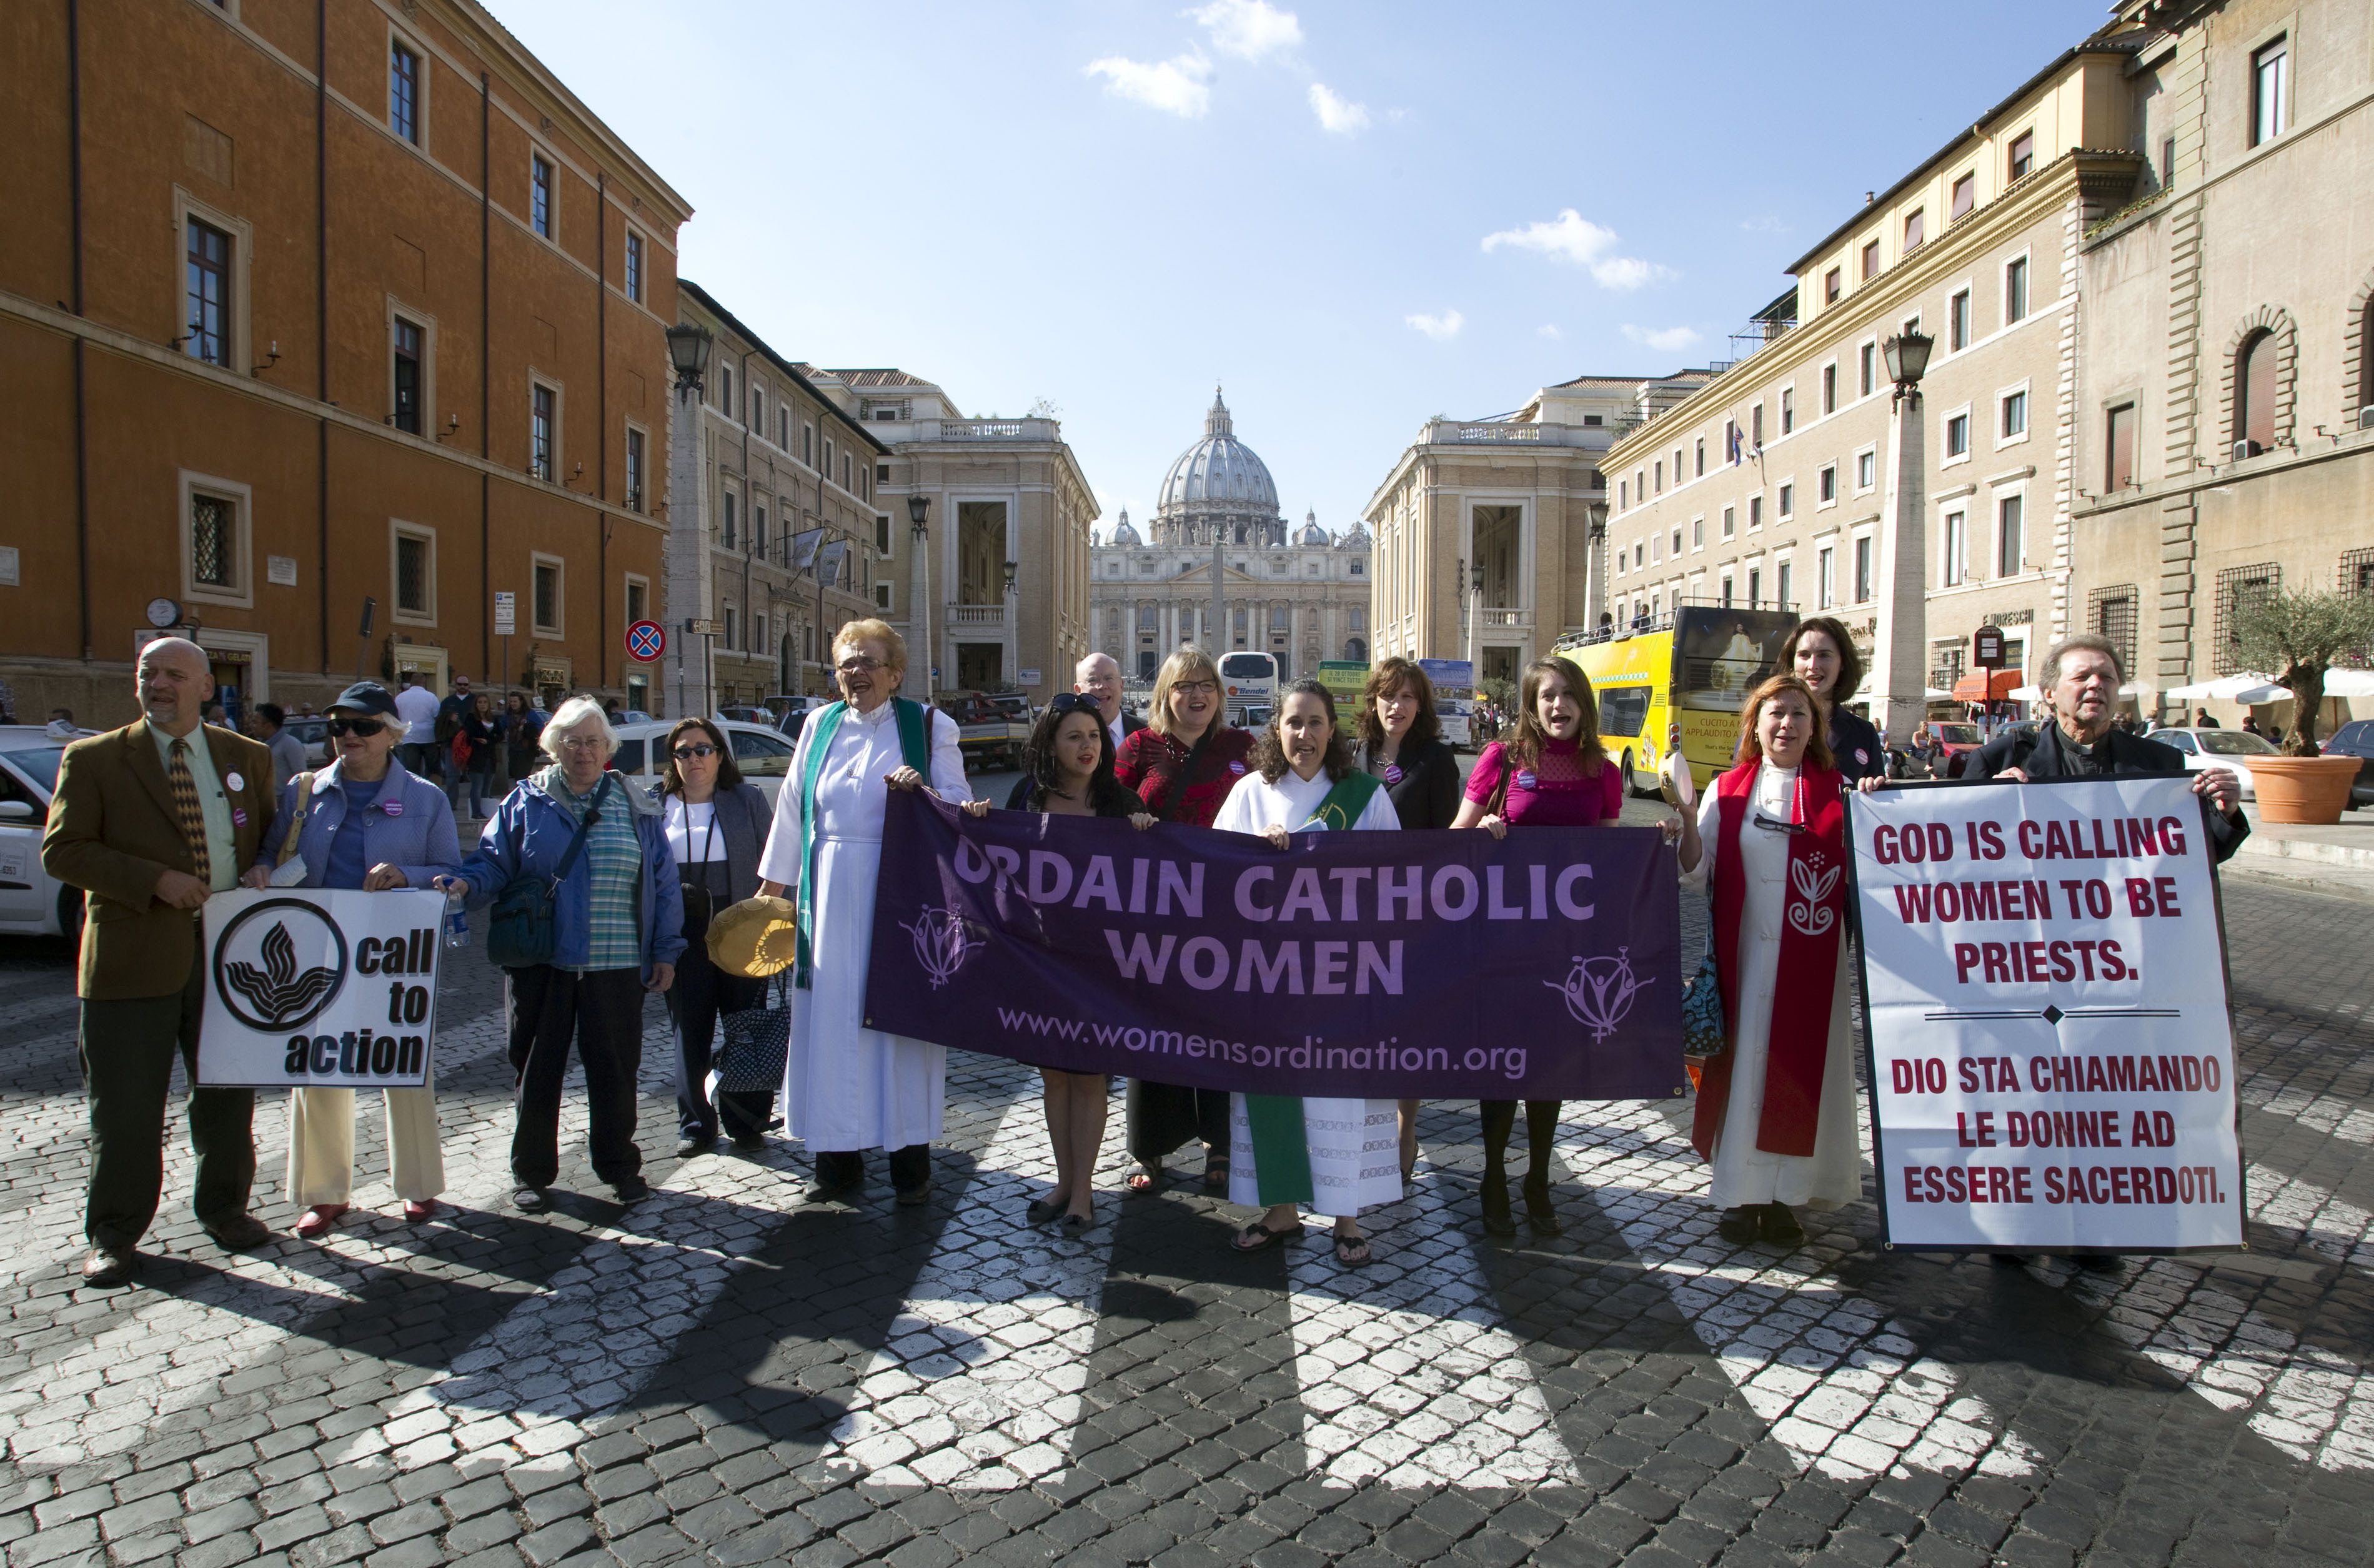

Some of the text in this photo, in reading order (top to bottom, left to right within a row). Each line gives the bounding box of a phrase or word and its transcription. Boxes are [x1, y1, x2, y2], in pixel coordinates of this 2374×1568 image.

[1990, 608, 2034, 627] MORESCHI
[402, 661, 418, 672] BAR
[1685, 728, 1732, 738] APPLAUDITO
[1700, 718, 1728, 727] CUCITO
[1874, 816, 2187, 865] GOD IS CALLING
[953, 833, 1596, 922] ORDAIN CATHOLIC
[1894, 876, 2182, 924] WOMEN TO BE
[355, 928, 435, 975] call
[1103, 929, 1404, 995] WOMEN
[1954, 940, 2139, 984] PRIESTS.
[389, 981, 429, 1024] to
[284, 1028, 424, 1075] action
[998, 1007, 1527, 1079] www.womensordination.org
[1891, 1055, 2221, 1094] DIO STA CHIAMANDO
[1956, 1110, 2176, 1148] LE DONNE AD
[1904, 1166, 2225, 1204] ESSERE SACERDOTI.
